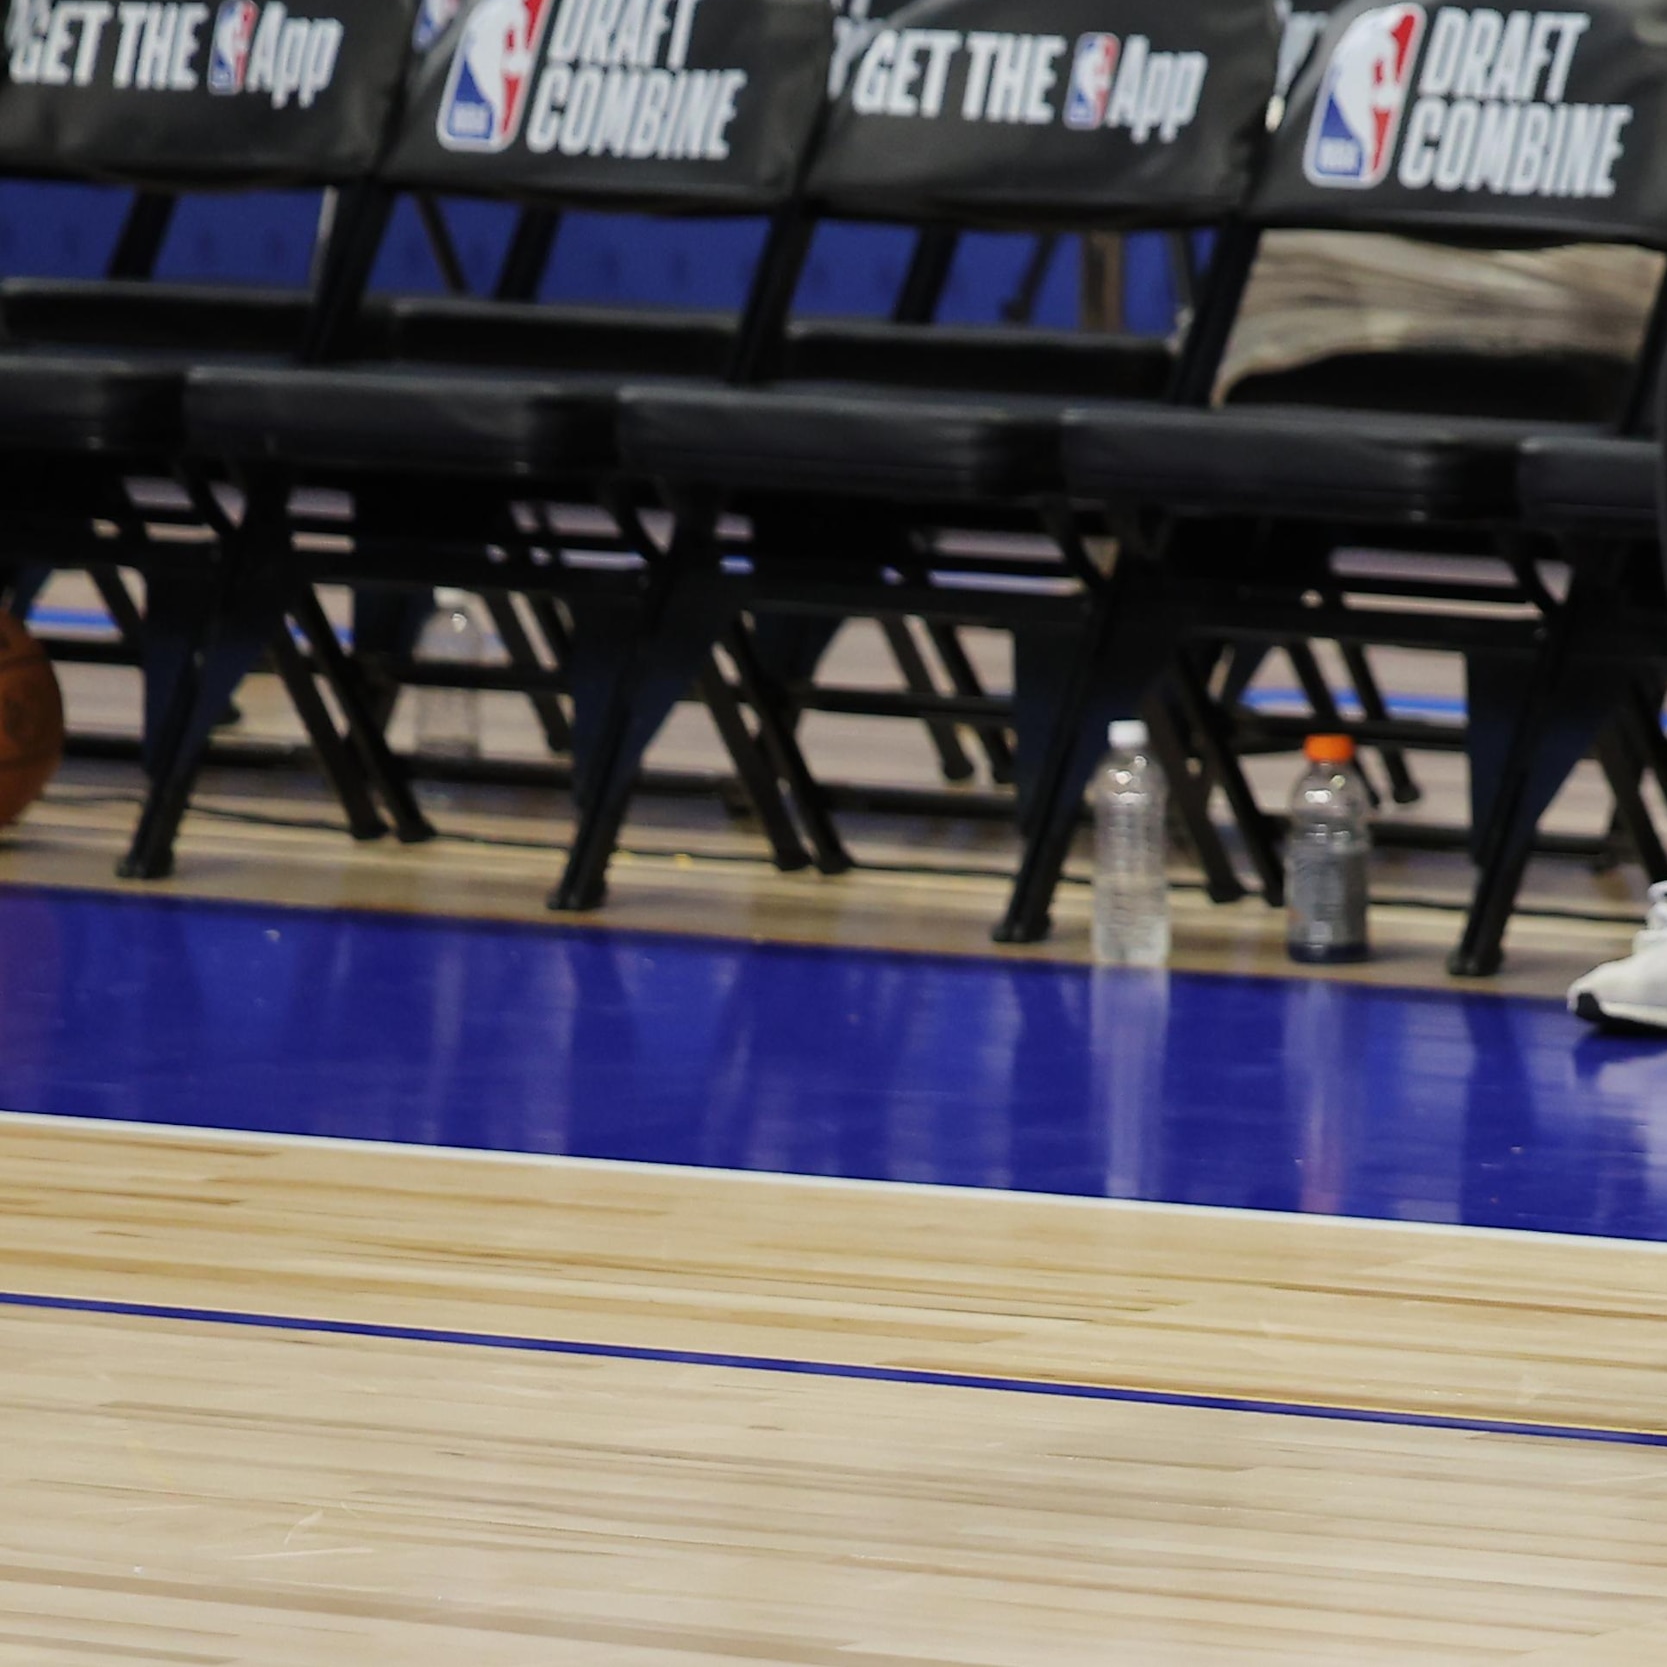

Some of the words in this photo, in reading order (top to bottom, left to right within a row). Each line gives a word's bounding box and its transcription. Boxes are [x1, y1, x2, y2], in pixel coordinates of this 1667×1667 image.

[8, 0, 114, 86] GET
[112, 1, 210, 91] THE
[245, 0, 345, 110] App
[852, 28, 962, 120] GET
[961, 31, 1068, 125] THE
[1103, 34, 1208, 144] App
[1419, 6, 1590, 104] DRAFT
[525, 65, 748, 160] COMBINE
[1398, 95, 1634, 198] COMBINE
